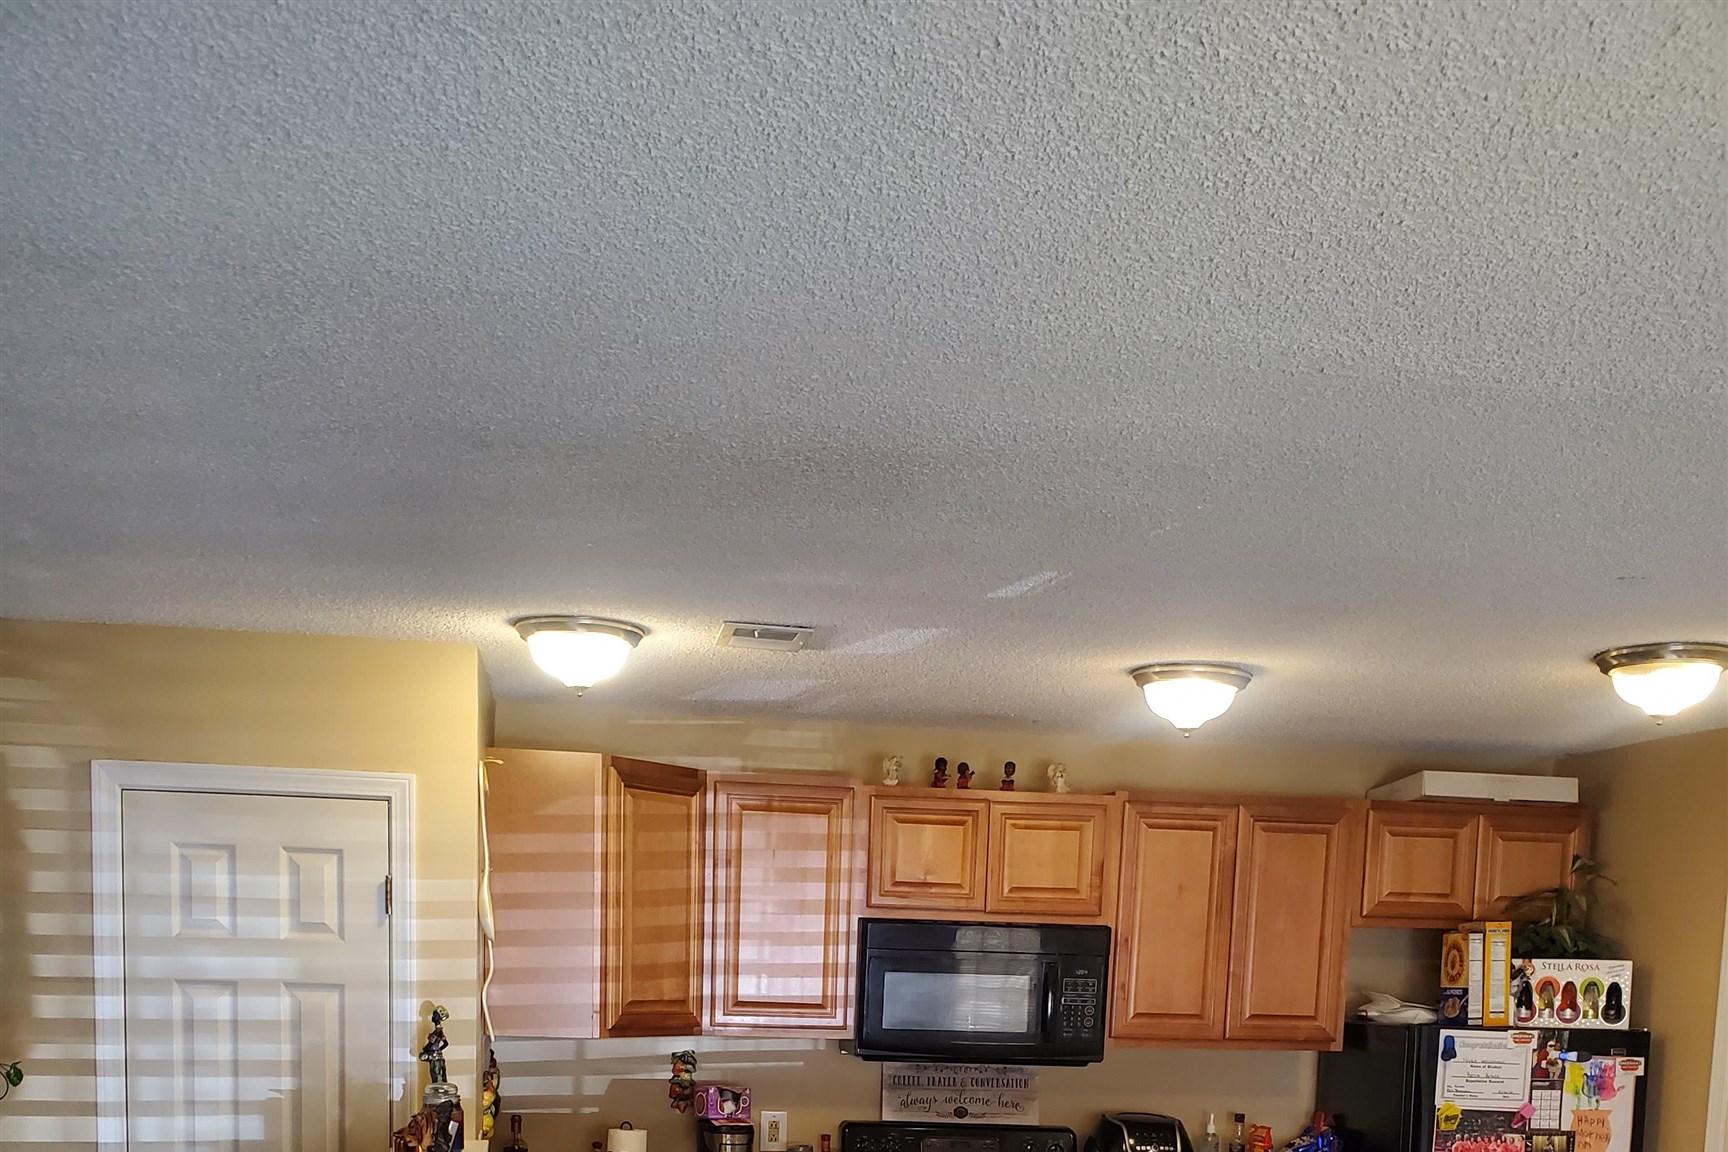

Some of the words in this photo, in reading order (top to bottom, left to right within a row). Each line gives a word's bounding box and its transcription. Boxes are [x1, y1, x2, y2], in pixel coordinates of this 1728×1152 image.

[1542, 962, 1573, 972] STELLA
[1575, 963, 1601, 973] ROSA
[927, 1076, 956, 1087] PRAYER
[970, 1077, 1029, 1089] CONVERSATION
[900, 1091, 937, 1112] always
[944, 1089, 991, 1107] welcome
[997, 1093, 1025, 1112] here
